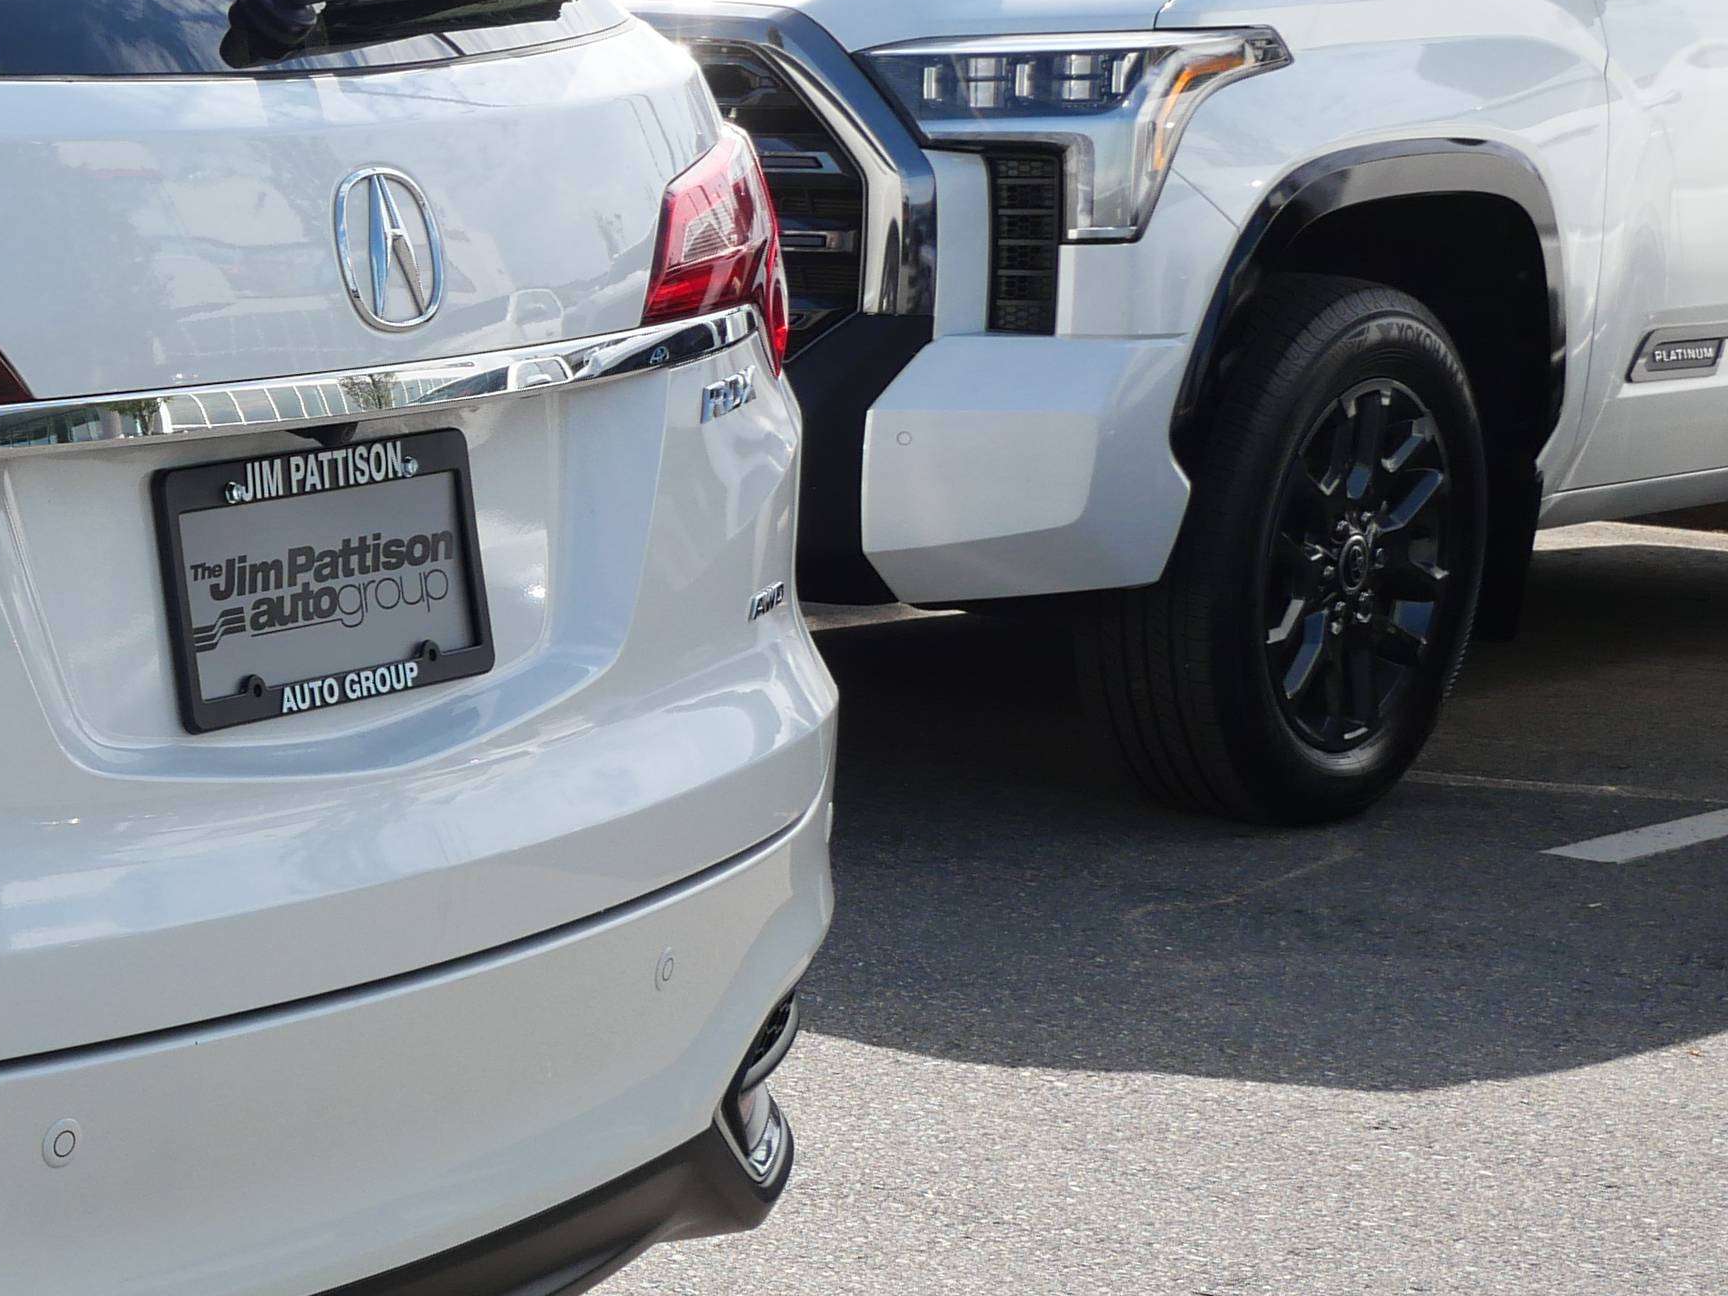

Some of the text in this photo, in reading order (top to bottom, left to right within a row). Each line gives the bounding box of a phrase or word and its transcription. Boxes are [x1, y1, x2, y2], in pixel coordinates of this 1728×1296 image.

[1654, 347, 1713, 362] PLATINUM
[700, 364, 756, 424] RDX
[242, 440, 402, 502] JIM PATTISON
[190, 562, 223, 582] The
[748, 581, 784, 622] AWD
[281, 661, 419, 713] AUTO GROUP
